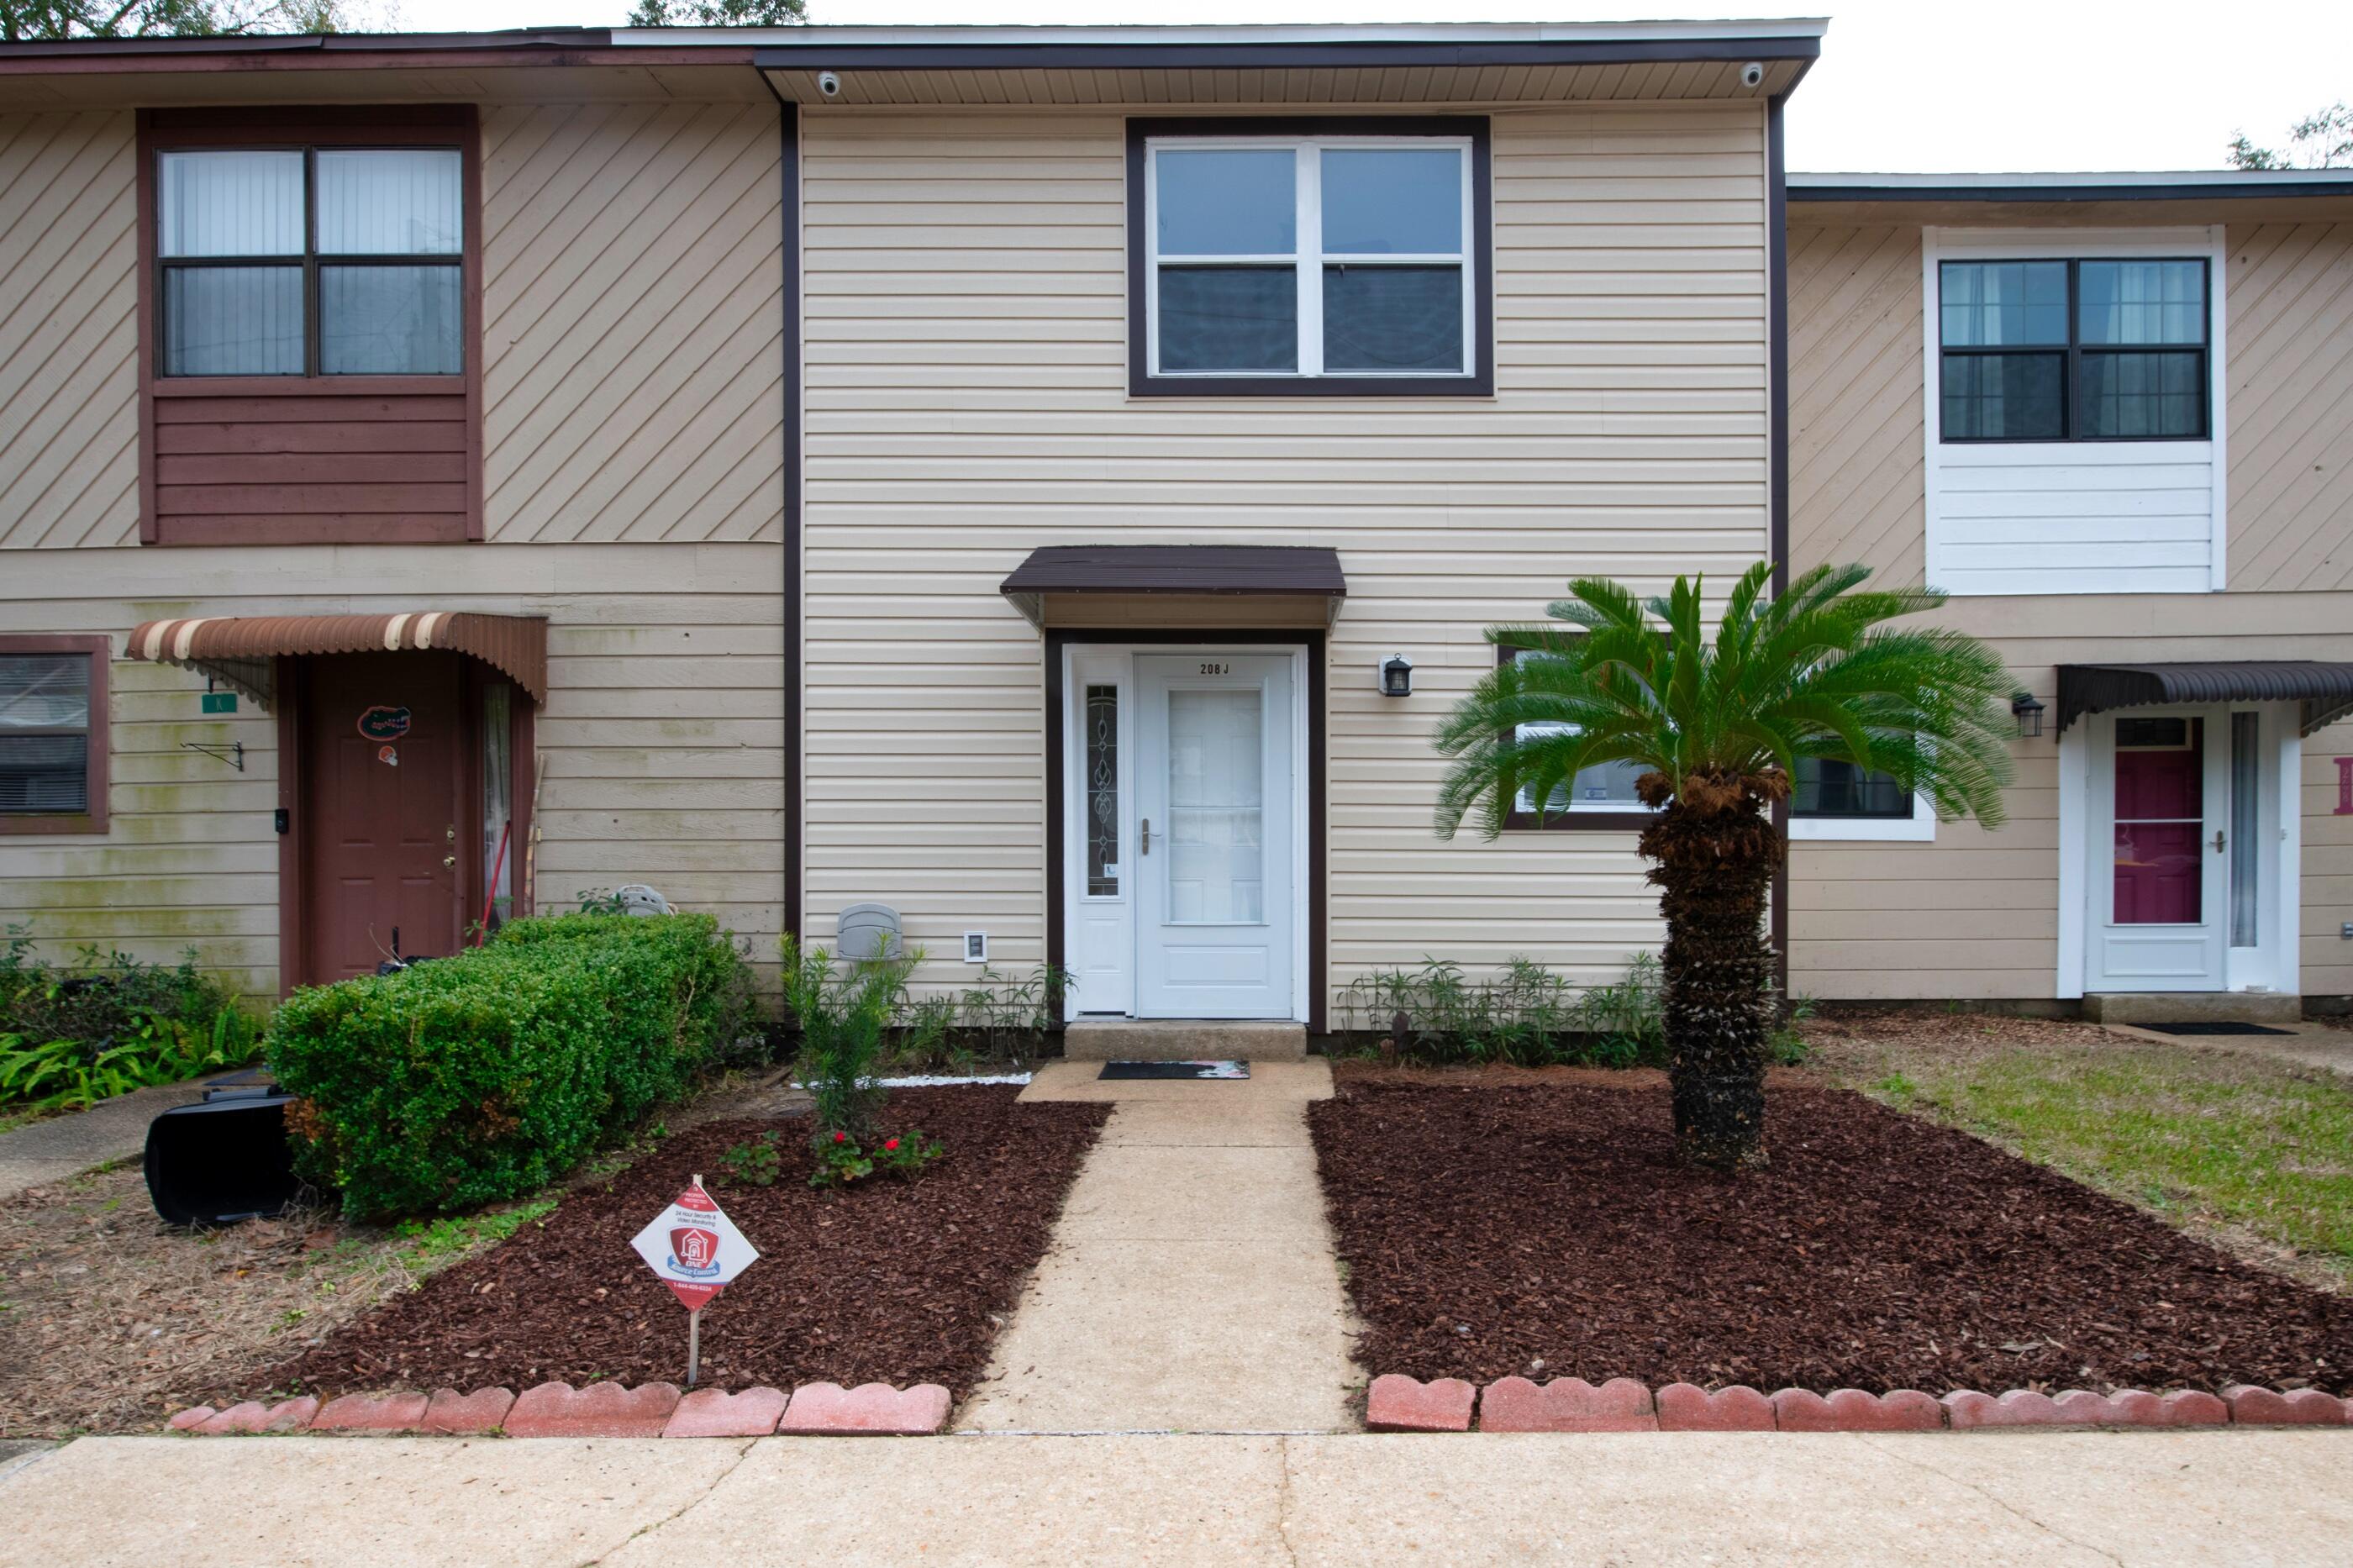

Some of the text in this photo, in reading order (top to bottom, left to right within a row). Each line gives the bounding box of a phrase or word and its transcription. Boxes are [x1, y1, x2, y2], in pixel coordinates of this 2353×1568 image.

[1200, 664, 1229, 675] 208 J
[216, 697, 223, 711] K
[693, 1268, 719, 1276] Control
